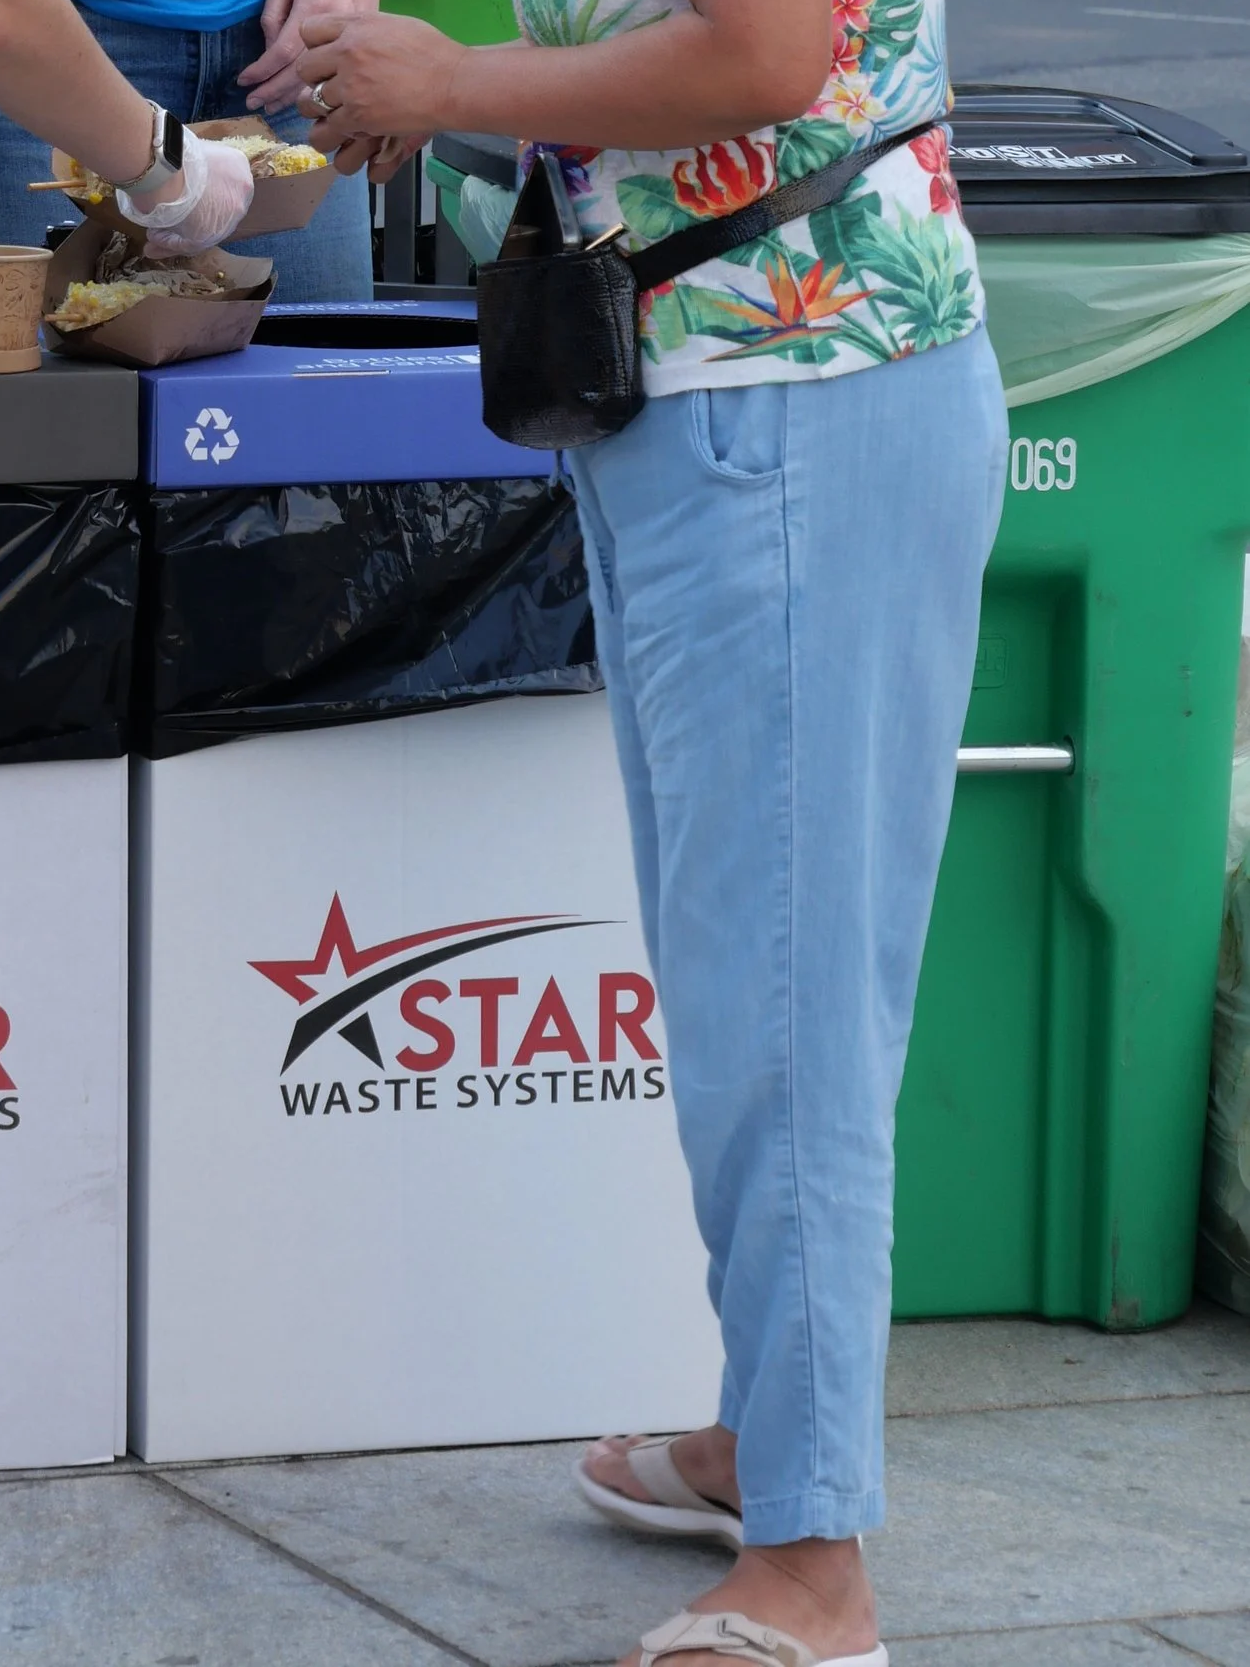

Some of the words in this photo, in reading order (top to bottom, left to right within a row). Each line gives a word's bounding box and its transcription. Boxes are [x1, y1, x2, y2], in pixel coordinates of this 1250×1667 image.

[949, 145, 1069, 161] OST
[1008, 437, 1078, 491] 069
[395, 971, 664, 1073] STAR
[280, 1077, 438, 1117] WASTE
[456, 1066, 667, 1109] SYSTEMS
